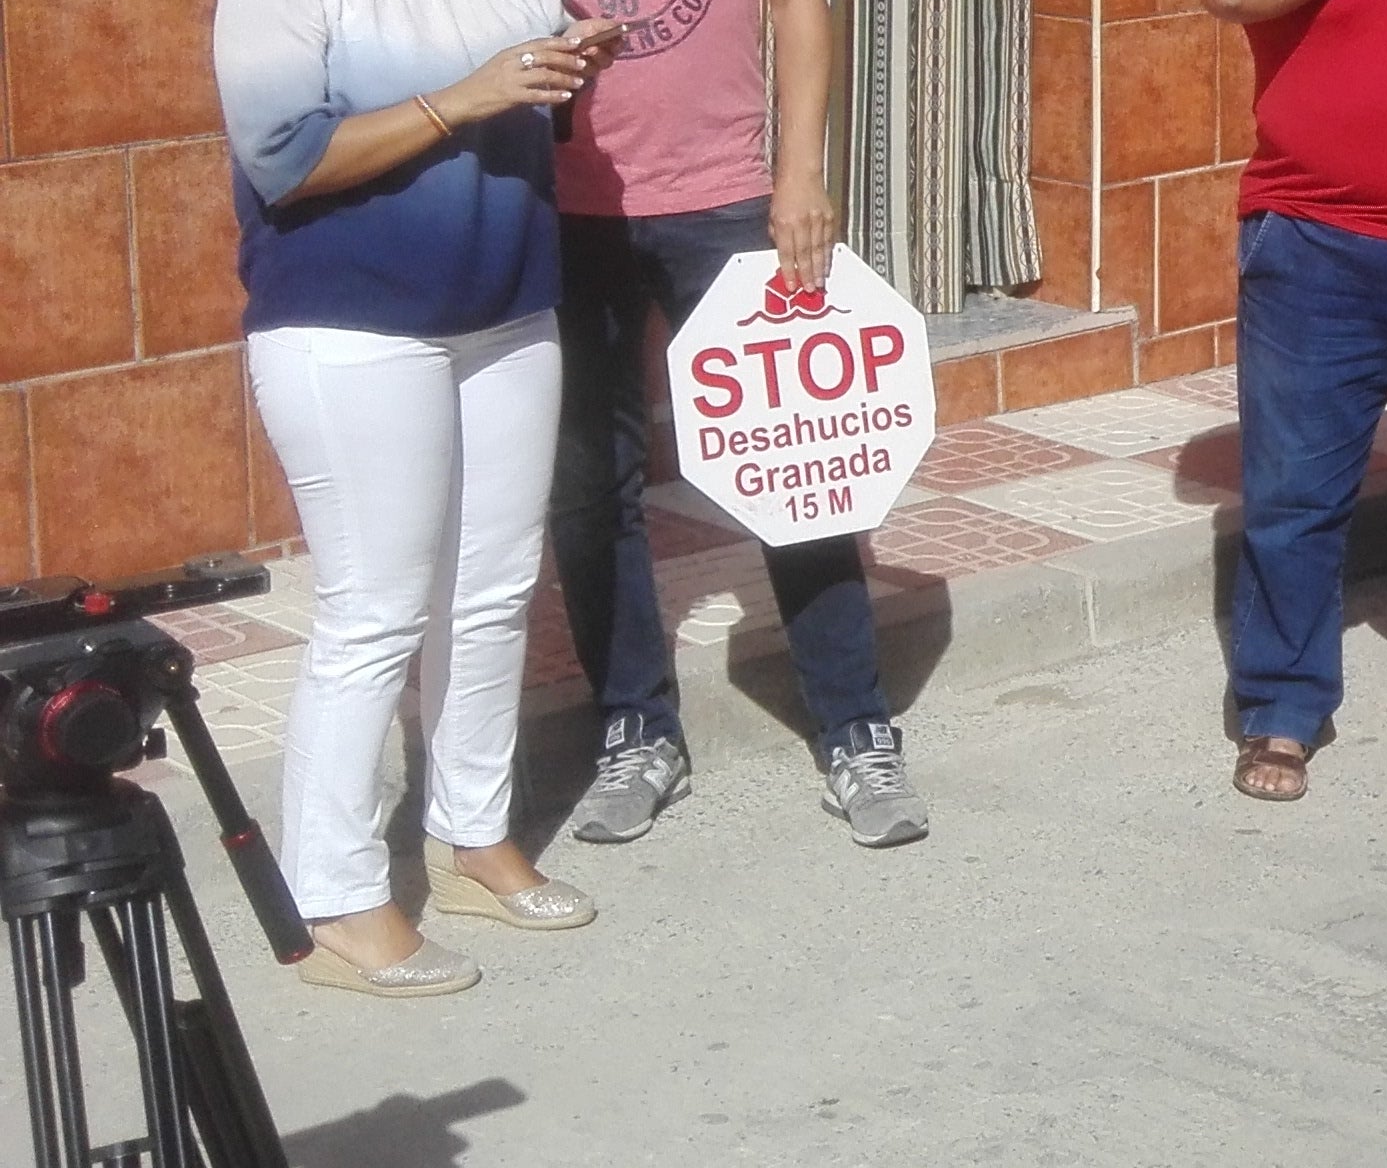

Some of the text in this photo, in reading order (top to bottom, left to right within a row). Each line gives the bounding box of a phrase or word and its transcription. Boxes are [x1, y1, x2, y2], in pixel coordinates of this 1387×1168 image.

[690, 323, 905, 420] STOP
[698, 401, 913, 462] Desahucios
[734, 442, 892, 498] Granada
[785, 485, 854, 523] 15 M
